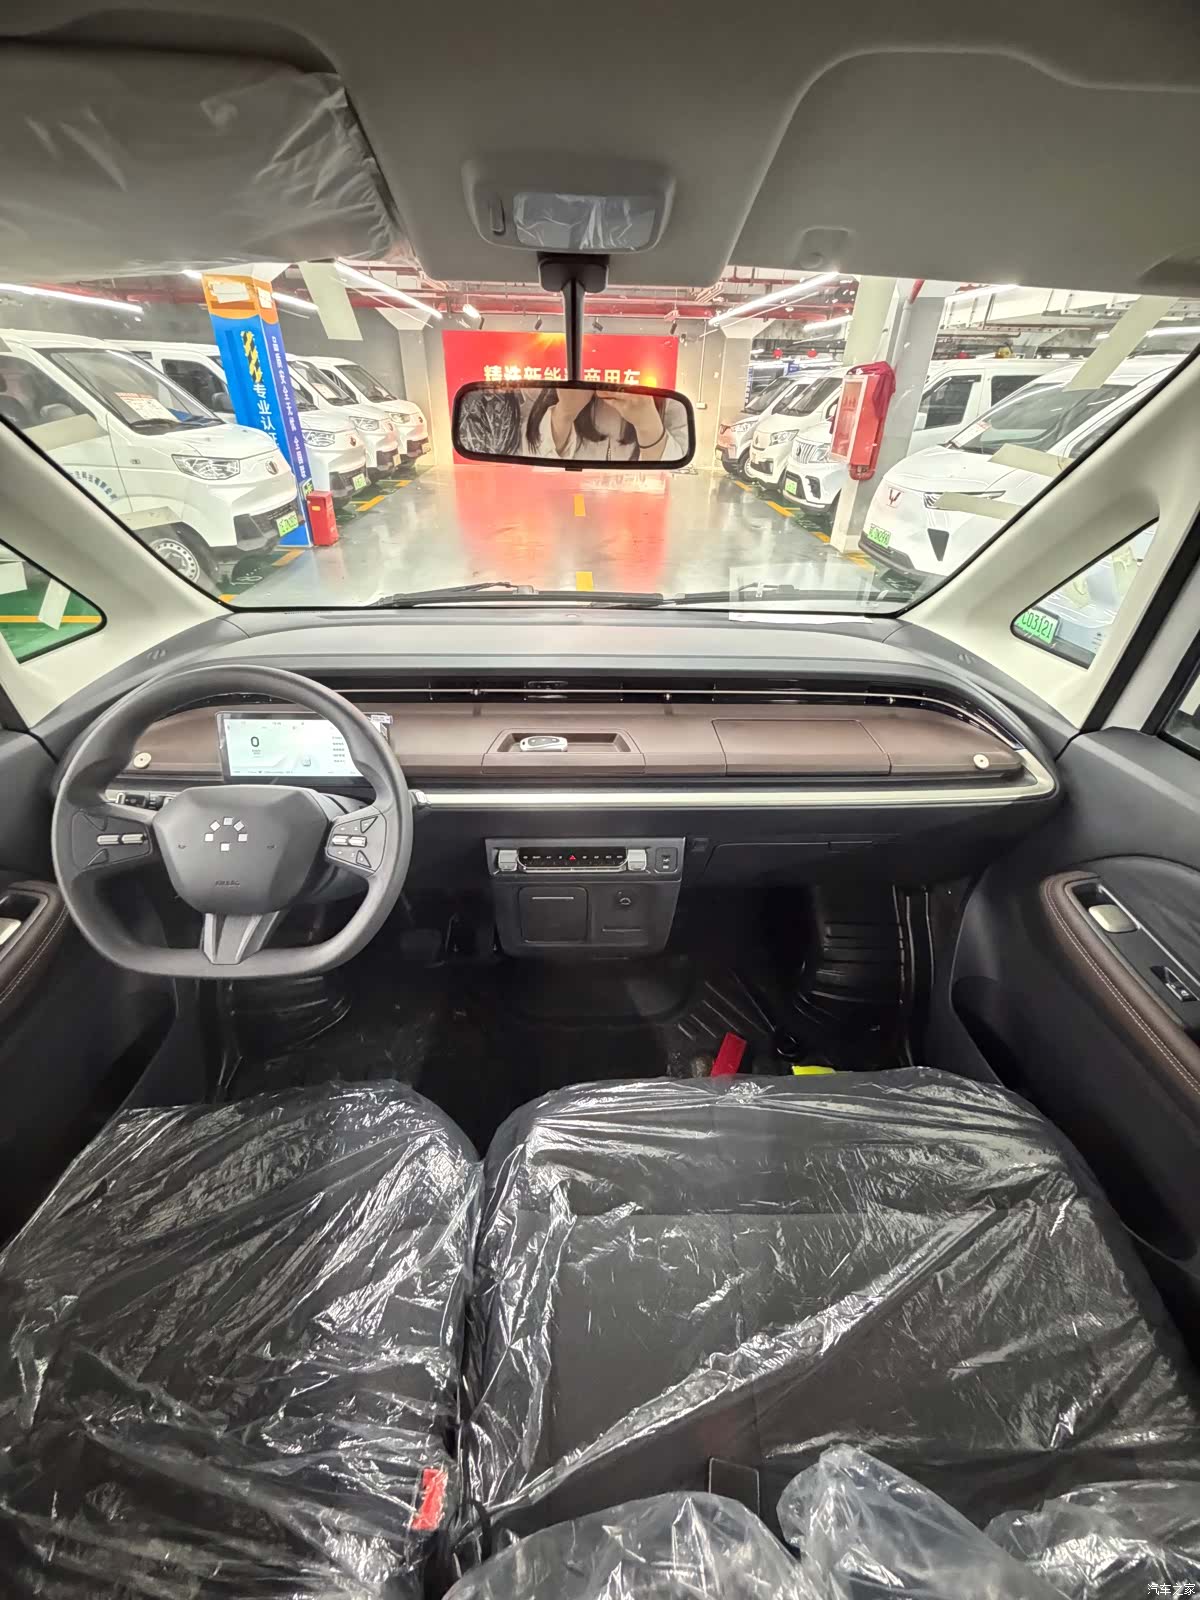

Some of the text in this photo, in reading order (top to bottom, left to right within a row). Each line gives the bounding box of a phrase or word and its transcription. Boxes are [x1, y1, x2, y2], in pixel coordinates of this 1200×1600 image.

[483, 364, 641, 385] 精选新能商用车
